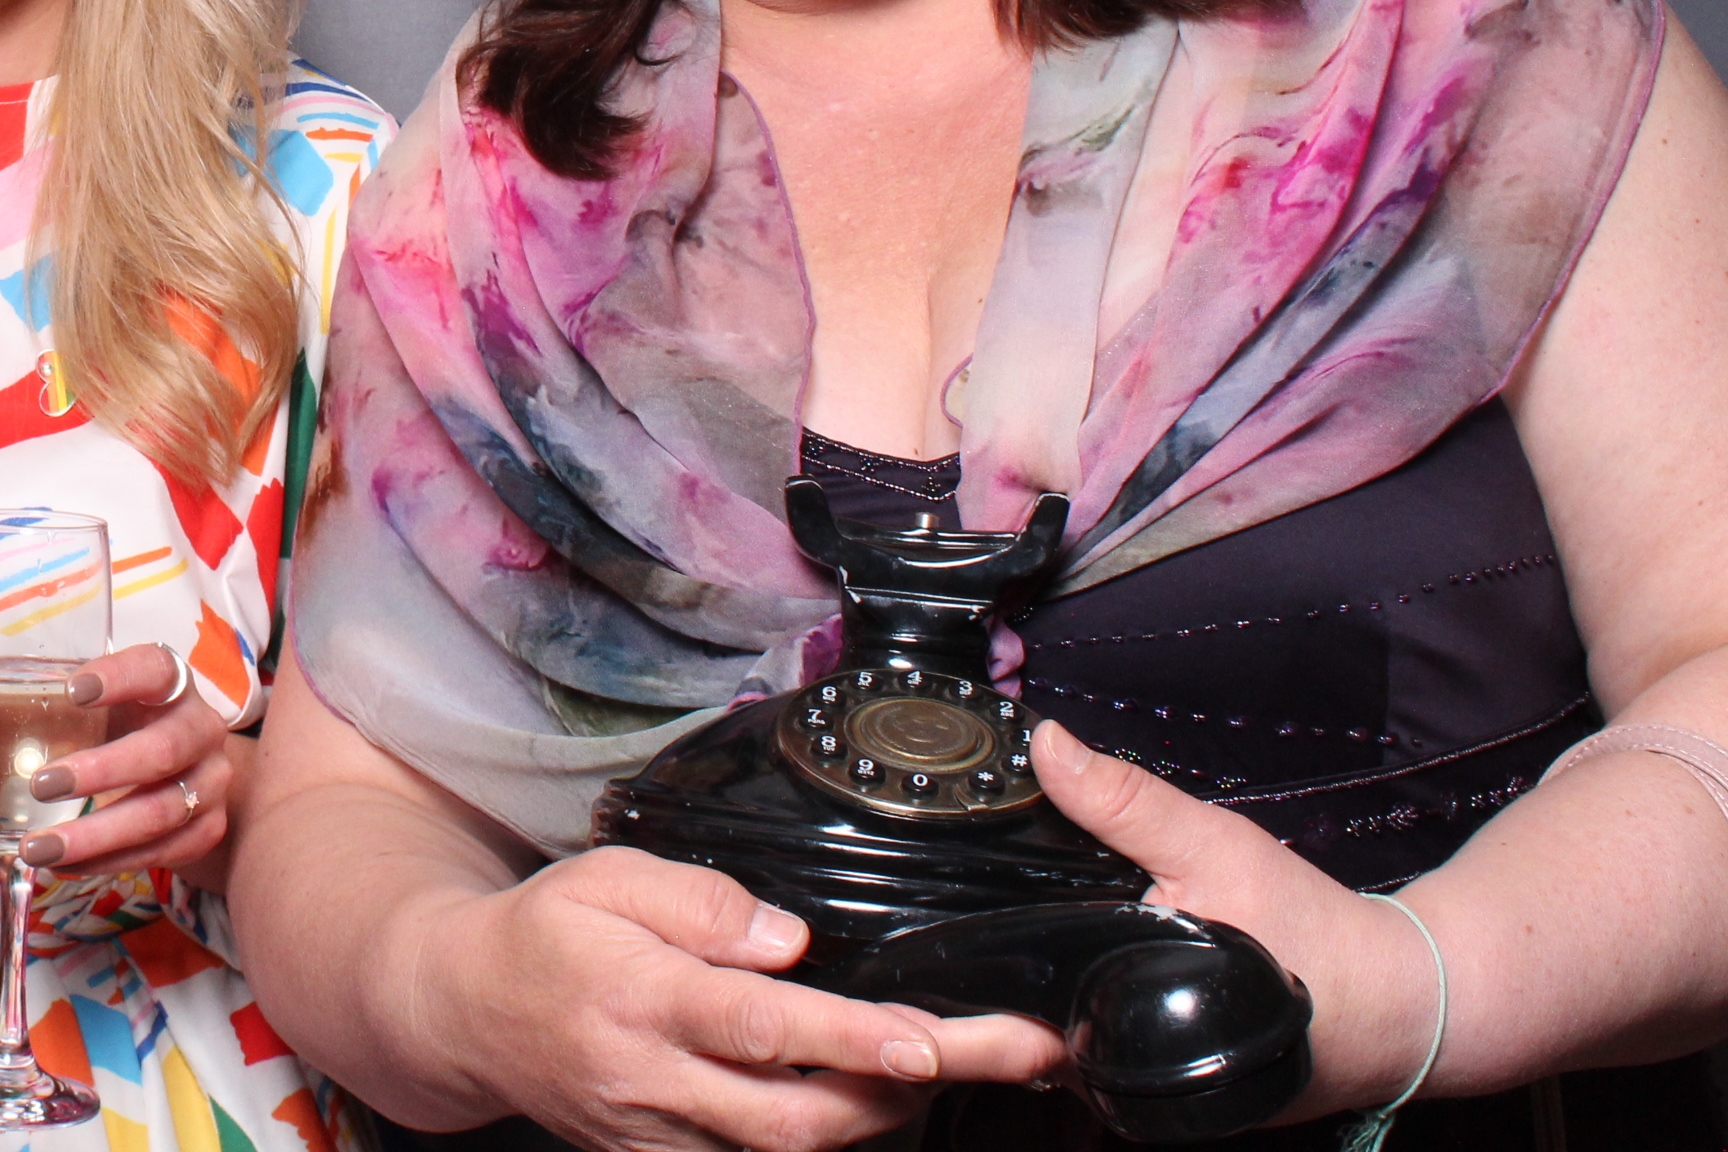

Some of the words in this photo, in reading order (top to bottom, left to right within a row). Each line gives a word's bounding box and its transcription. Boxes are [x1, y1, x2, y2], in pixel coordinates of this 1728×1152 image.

[858, 671, 873, 683] 5
[907, 670, 922, 682] 4
[822, 686, 837, 697] 6
[959, 680, 973, 692] 3
[999, 701, 1014, 712] 2
[808, 708, 822, 721] 7
[821, 735, 836, 747] 8
[1022, 730, 1031, 742] 1
[858, 759, 874, 770] 9
